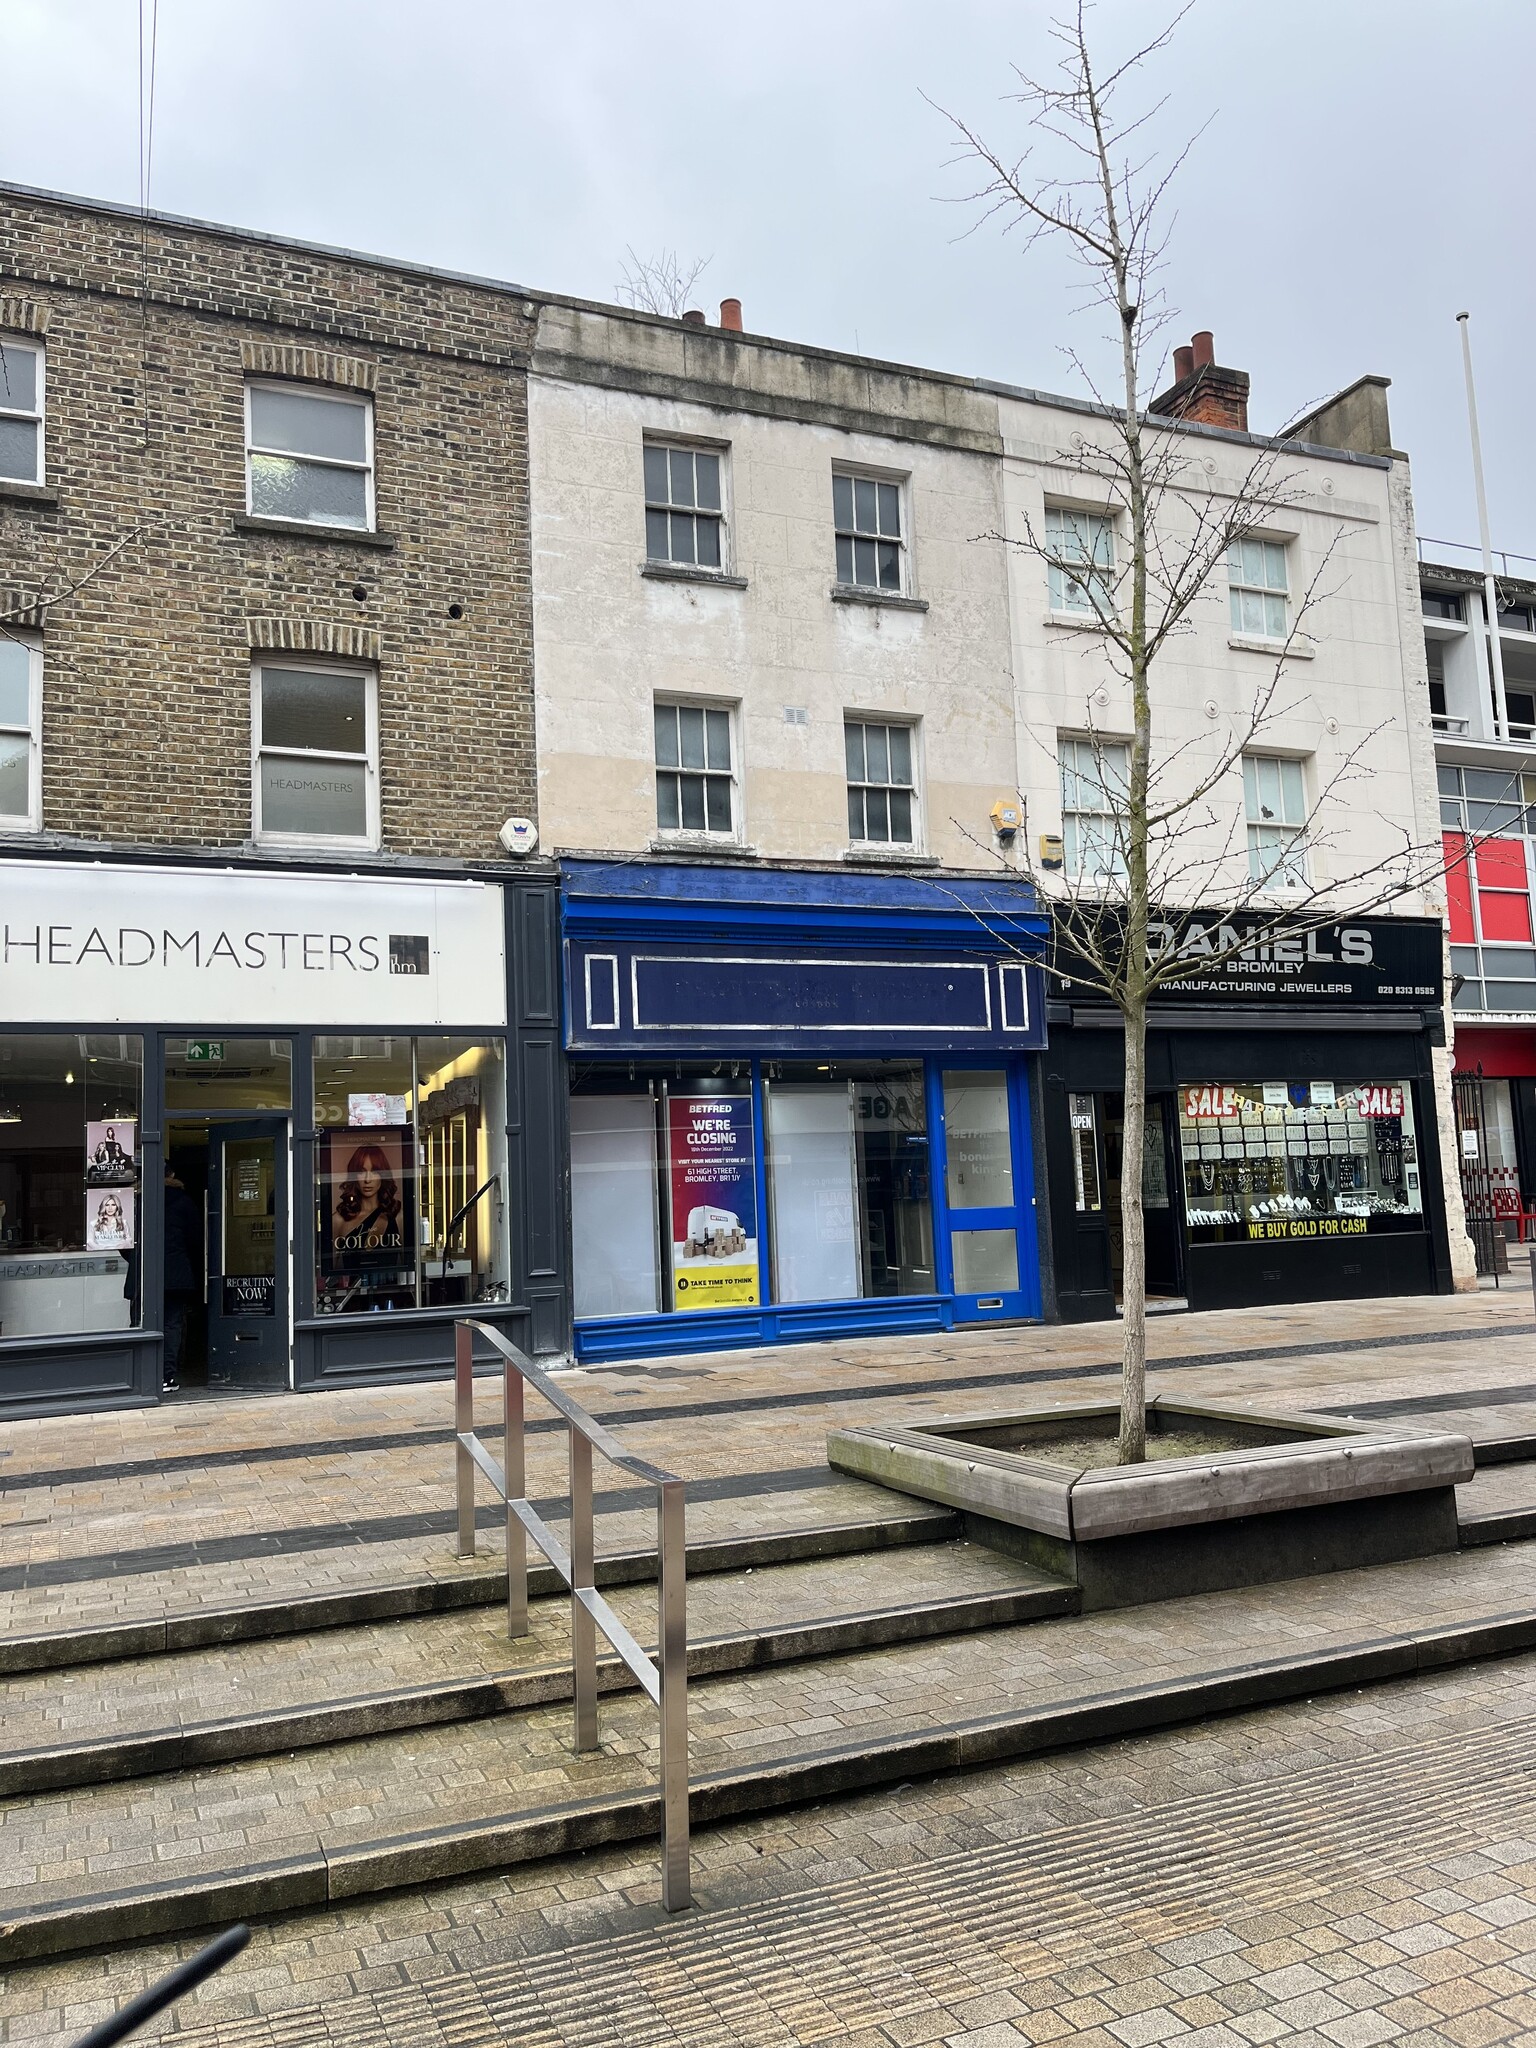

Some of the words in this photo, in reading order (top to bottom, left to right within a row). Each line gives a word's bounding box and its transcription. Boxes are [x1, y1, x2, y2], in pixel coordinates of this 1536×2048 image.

[270, 779, 353, 793] HEADMASTERS
[4, 924, 380, 972] HEADMASTERS
[1227, 962, 1305, 975] BROMLEY
[1158, 981, 1276, 993] MANUFACTURING
[1280, 983, 1352, 995] JEWELLERS
[1378, 985, 1394, 994] 020
[1395, 986, 1413, 995] 8313
[1415, 986, 1435, 995] 0585
[1187, 1087, 1235, 1116] SALE
[1360, 1087, 1402, 1115] SALE
[689, 1104, 732, 1114] BETFRED
[692, 1119, 731, 1131] WE'RE
[1072, 1115, 1092, 1129] OPEN
[686, 1132, 737, 1145] CLOSING
[687, 1168, 696, 1176] 61
[1248, 1223, 1265, 1239] WE
[1267, 1222, 1287, 1238] BUY
[1290, 1221, 1317, 1236] GOLD
[1319, 1220, 1340, 1235] FOR
[1341, 1219, 1367, 1234] CASH
[334, 1233, 402, 1250] COLOUR
[690, 1279, 707, 1287] TAKE
[734, 1277, 753, 1285] THINK
[236, 1287, 267, 1301] NOW!
